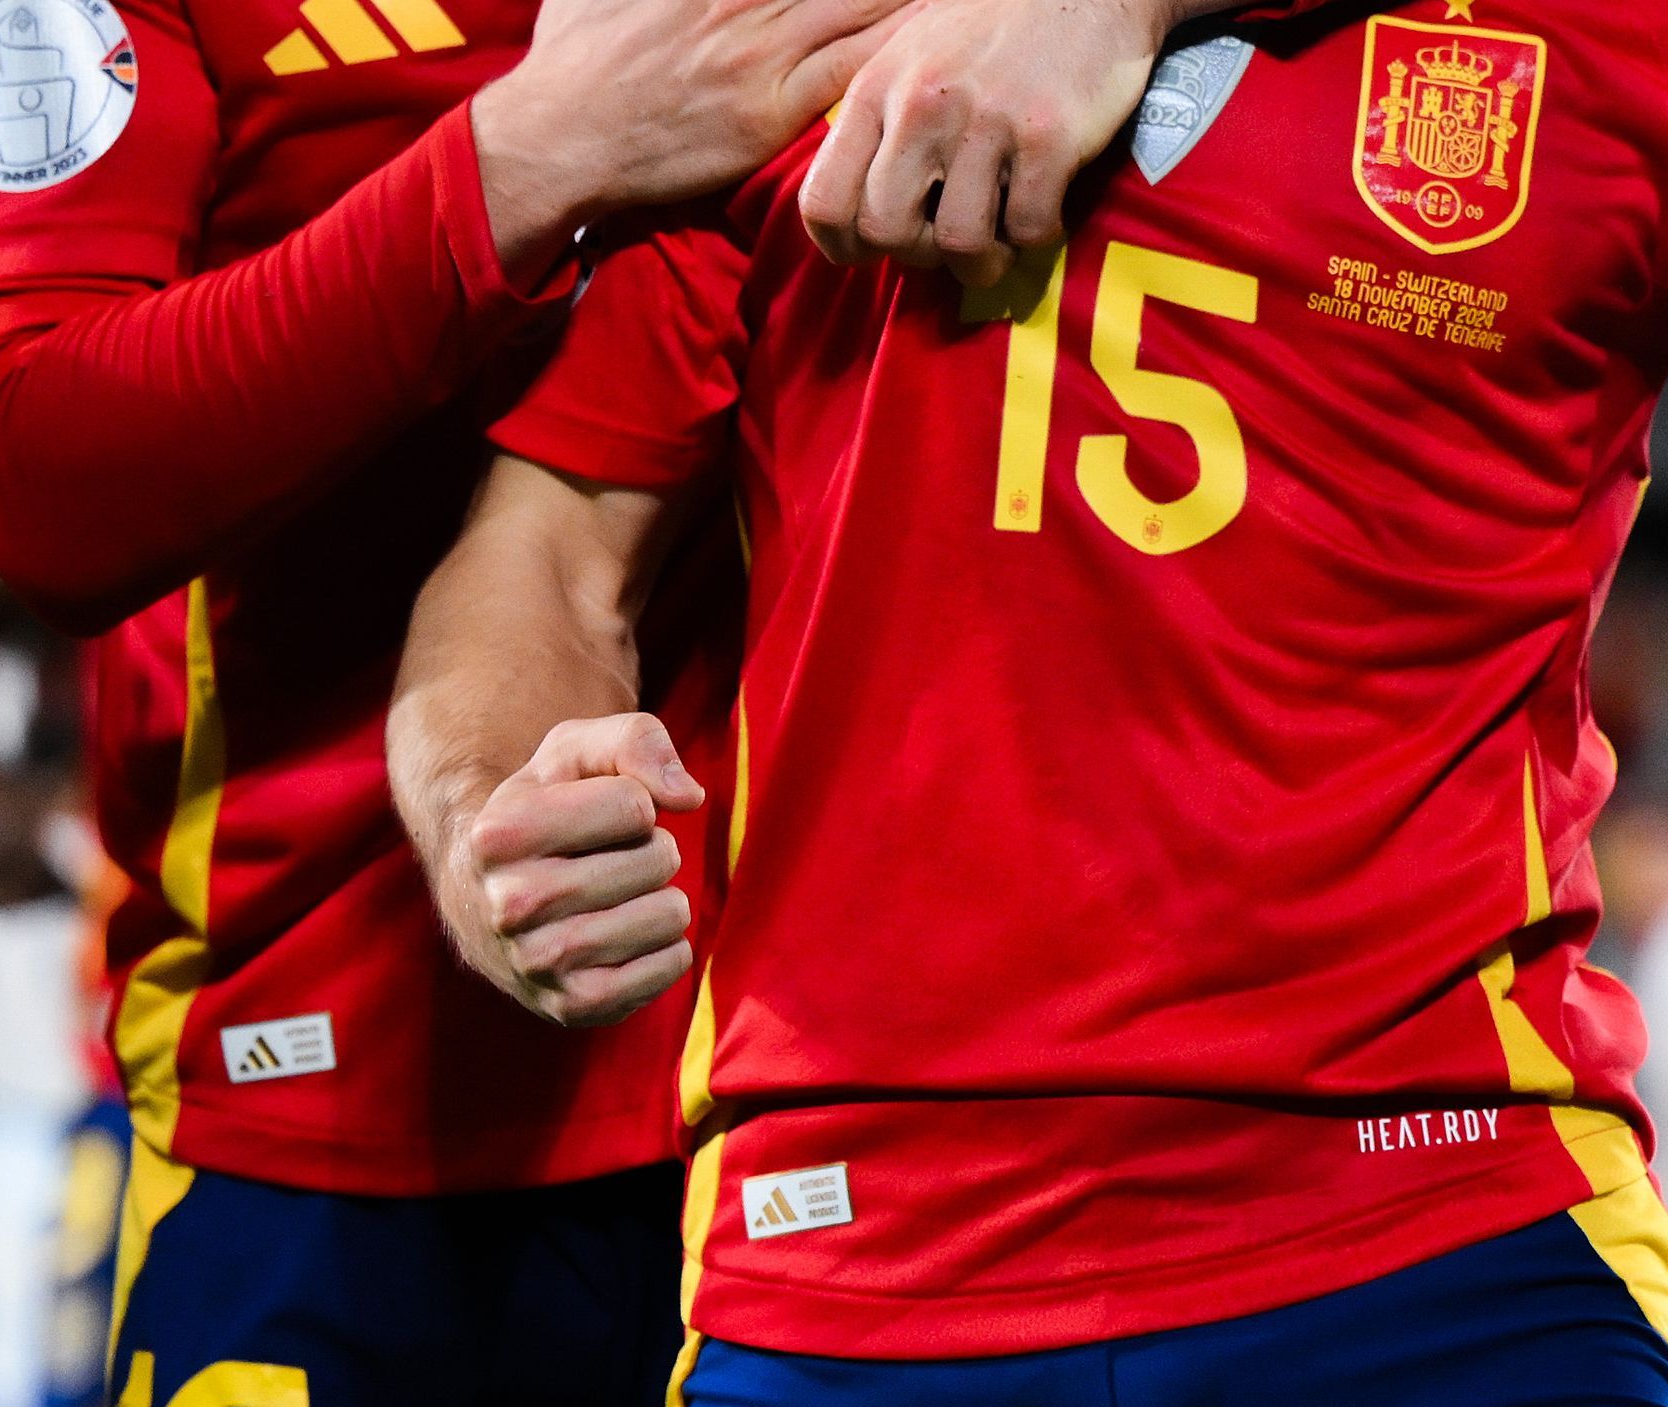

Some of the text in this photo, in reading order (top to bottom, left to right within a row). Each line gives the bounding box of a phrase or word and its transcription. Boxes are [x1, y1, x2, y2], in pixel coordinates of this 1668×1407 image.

[1140, 104, 1194, 126] 024
[1327, 255, 1378, 284] SPAIN
[1395, 270, 1509, 312] SWITZERLAND
[1333, 278, 1496, 330] 18 NOVEMBER 2024
[1306, 292, 1507, 353] SANTA CRUZ DE TENERIFE
[960, 240, 1258, 556] 15
[1357, 1108, 1498, 1153] HEAT.RDY
